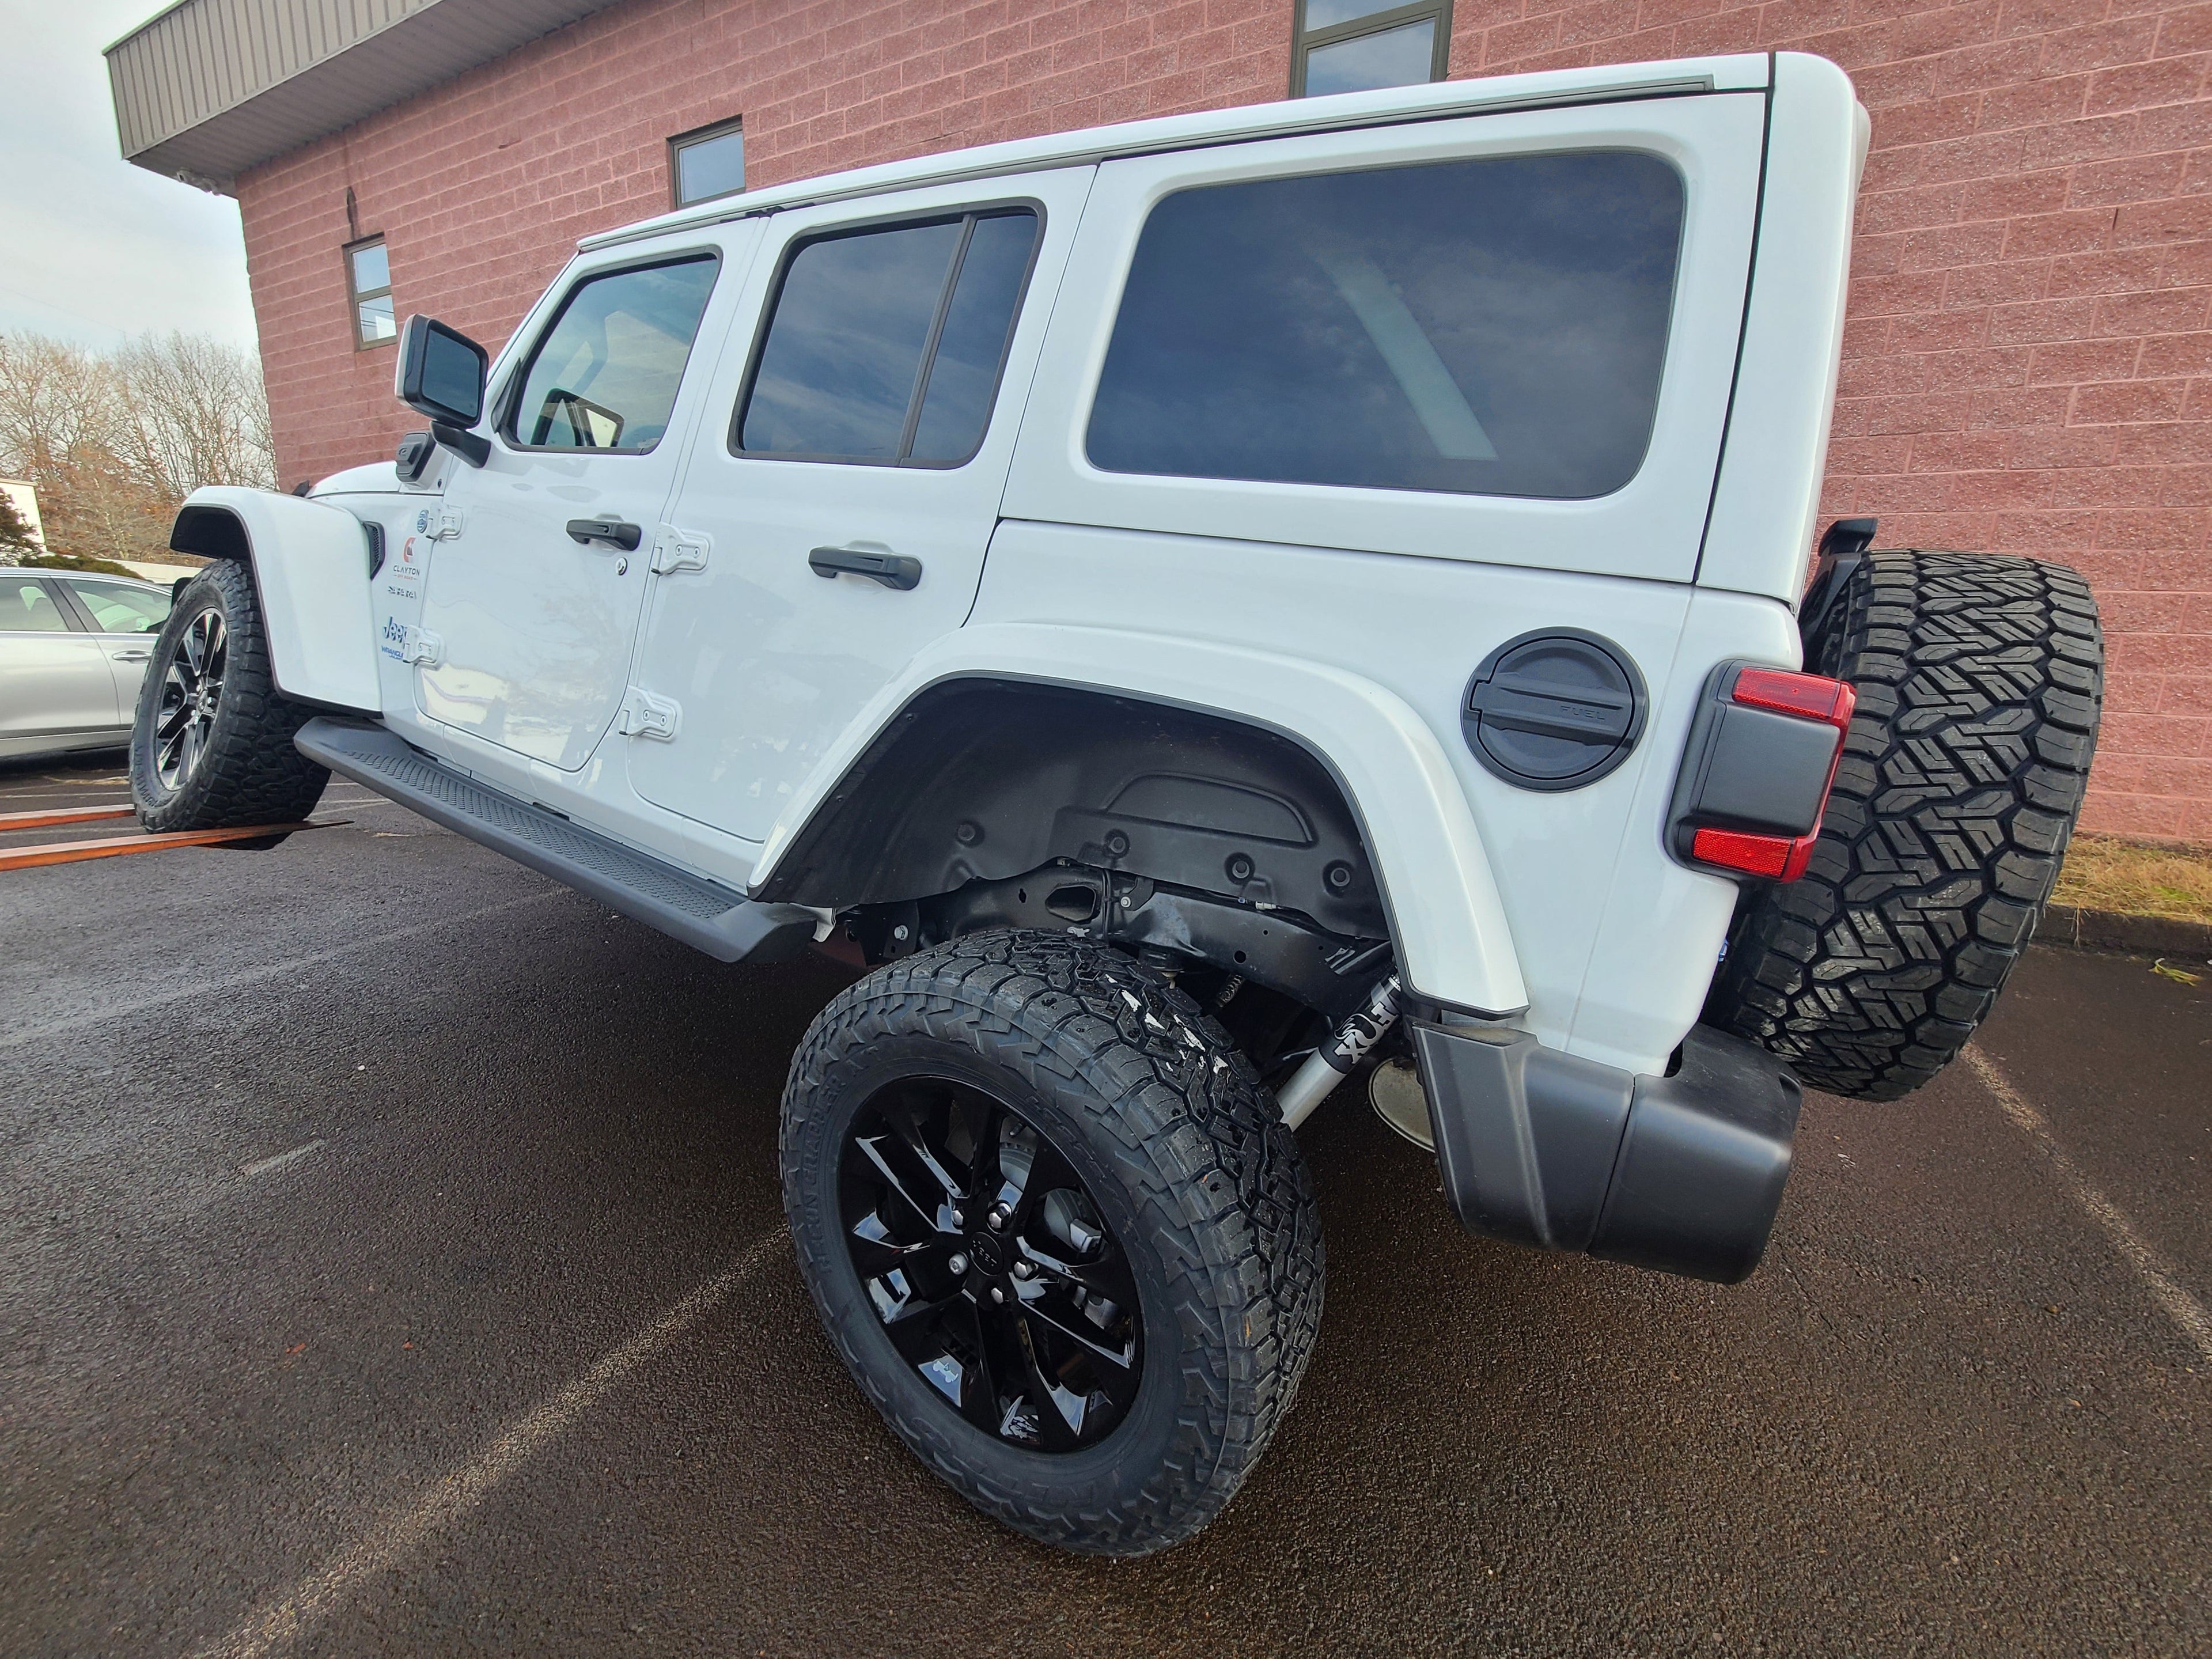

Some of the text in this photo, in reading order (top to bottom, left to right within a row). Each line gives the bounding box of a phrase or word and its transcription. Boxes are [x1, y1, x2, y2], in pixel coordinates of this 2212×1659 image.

[393, 565, 420, 576] CLAYTON
[1560, 706, 1606, 721] FUEL
[1333, 1002, 1399, 1065] FOX
